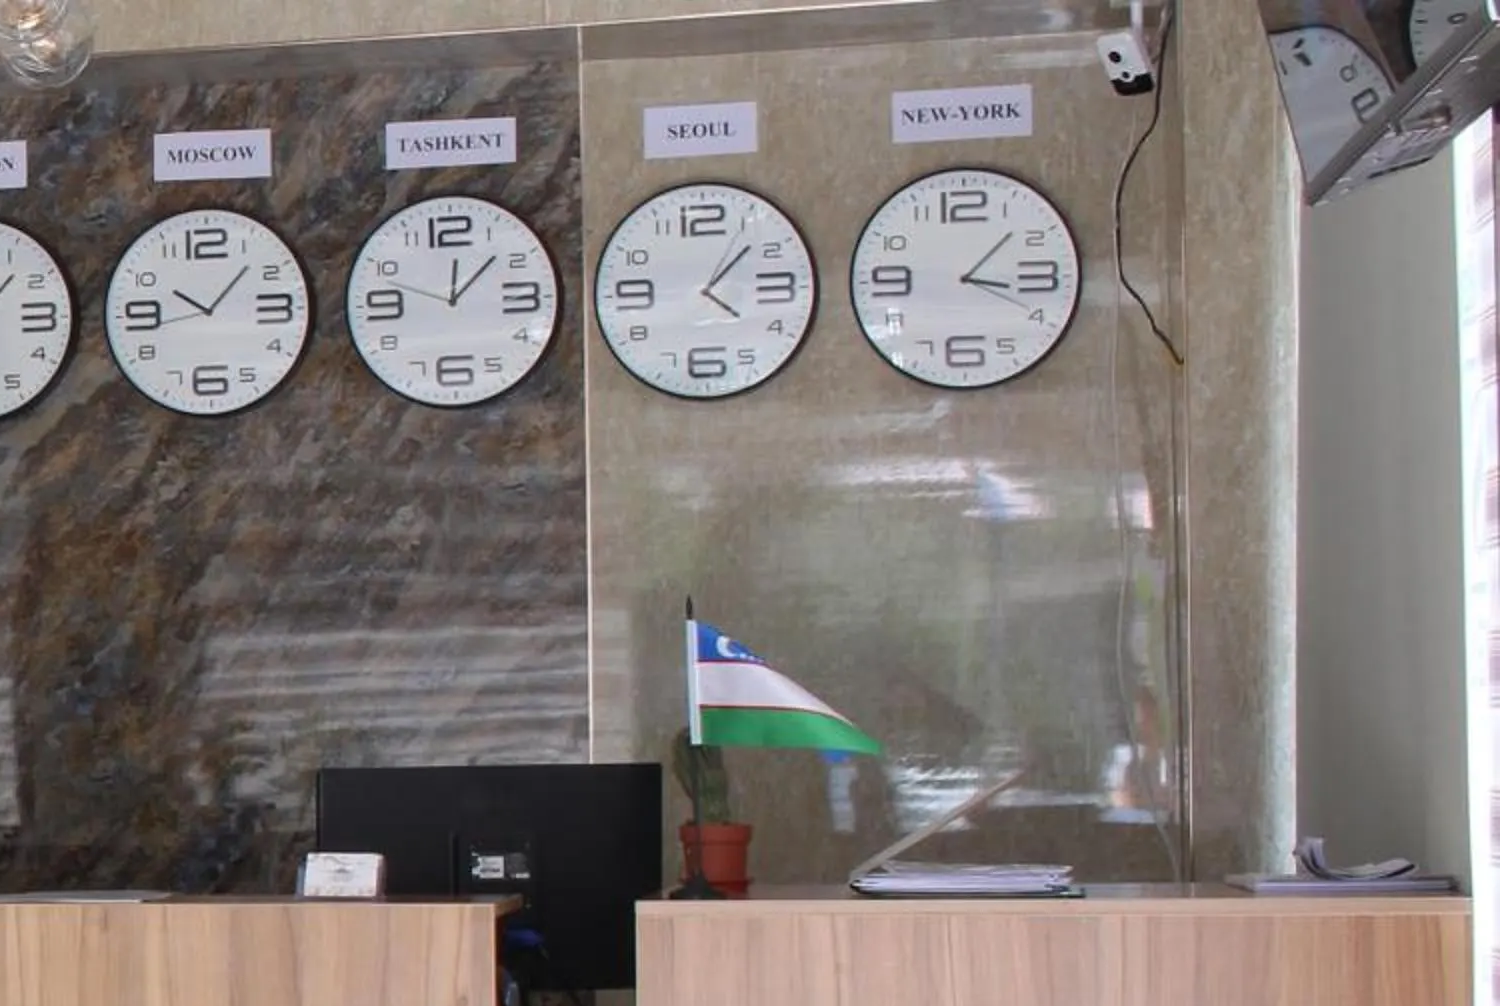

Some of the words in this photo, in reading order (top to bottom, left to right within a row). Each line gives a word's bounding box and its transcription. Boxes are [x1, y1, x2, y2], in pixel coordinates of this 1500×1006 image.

[901, 102, 1021, 125] NEW-YORK
[667, 121, 736, 140] SEOUL
[397, 132, 505, 153] TASHKENT
[167, 145, 257, 165] MOSCOW
[914, 205, 929, 222] 11
[940, 190, 988, 223] 12
[655, 219, 670, 235] 11
[679, 203, 726, 238] 12
[404, 231, 419, 246] 11
[428, 216, 472, 248] 12
[1025, 230, 1045, 246] 2
[162, 242, 176, 258] 11
[186, 228, 228, 260] 12
[763, 242, 782, 258] 2
[883, 235, 907, 251] 10
[509, 253, 526, 268] 2
[626, 250, 649, 266] 10
[263, 265, 280, 280] 2
[376, 261, 398, 276] 10
[1018, 260, 1059, 293] 3
[27, 274, 45, 288] 2
[136, 272, 156, 287] 10
[871, 265, 912, 297] 9
[616, 279, 654, 310] 9
[756, 271, 796, 305] 3
[366, 289, 404, 321] 9
[502, 281, 541, 314] 3
[125, 300, 161, 331] 9
[256, 293, 293, 324] 3
[1028, 308, 1044, 324] 4
[22, 302, 57, 332] 3
[630, 326, 648, 341] 8
[766, 319, 784, 334] 4
[380, 336, 398, 350] 8
[512, 328, 528, 343] 4
[30, 347, 46, 360] 4
[139, 345, 155, 360] 8
[266, 339, 281, 352] 4
[916, 340, 934, 355] 7
[945, 335, 986, 368] 6
[996, 338, 1016, 354] 5
[484, 357, 501, 372] 5
[660, 352, 677, 368] 7
[687, 346, 727, 379] 6
[737, 349, 755, 365] 5
[239, 367, 256, 382] 5
[409, 361, 426, 376] 7
[436, 355, 474, 386] 6
[4, 374, 20, 388] 5
[166, 371, 183, 385] 7
[192, 365, 229, 395] 6
